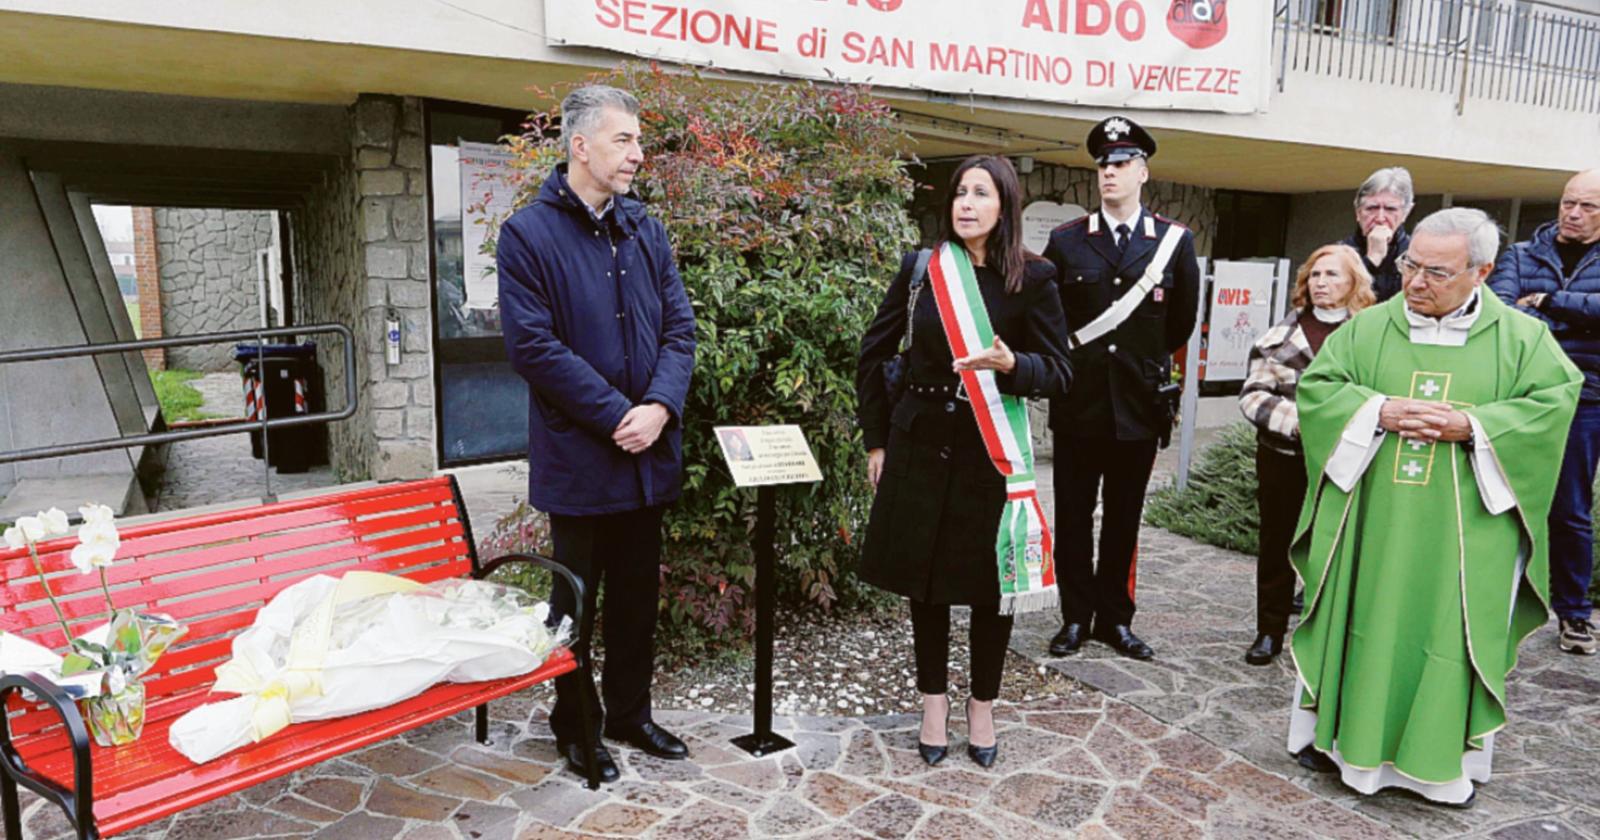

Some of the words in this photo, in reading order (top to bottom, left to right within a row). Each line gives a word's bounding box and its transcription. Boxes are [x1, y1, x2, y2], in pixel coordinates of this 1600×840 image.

[1022, 0, 1146, 41] AIDO
[595, 0, 779, 53] SEZIONE
[796, 27, 828, 59] di
[841, 31, 915, 69] SAN
[929, 42, 1073, 85] MARTINO
[1086, 60, 1115, 88] DI
[1128, 64, 1241, 95] VENEZZE
[1217, 288, 1251, 306] AVIS
